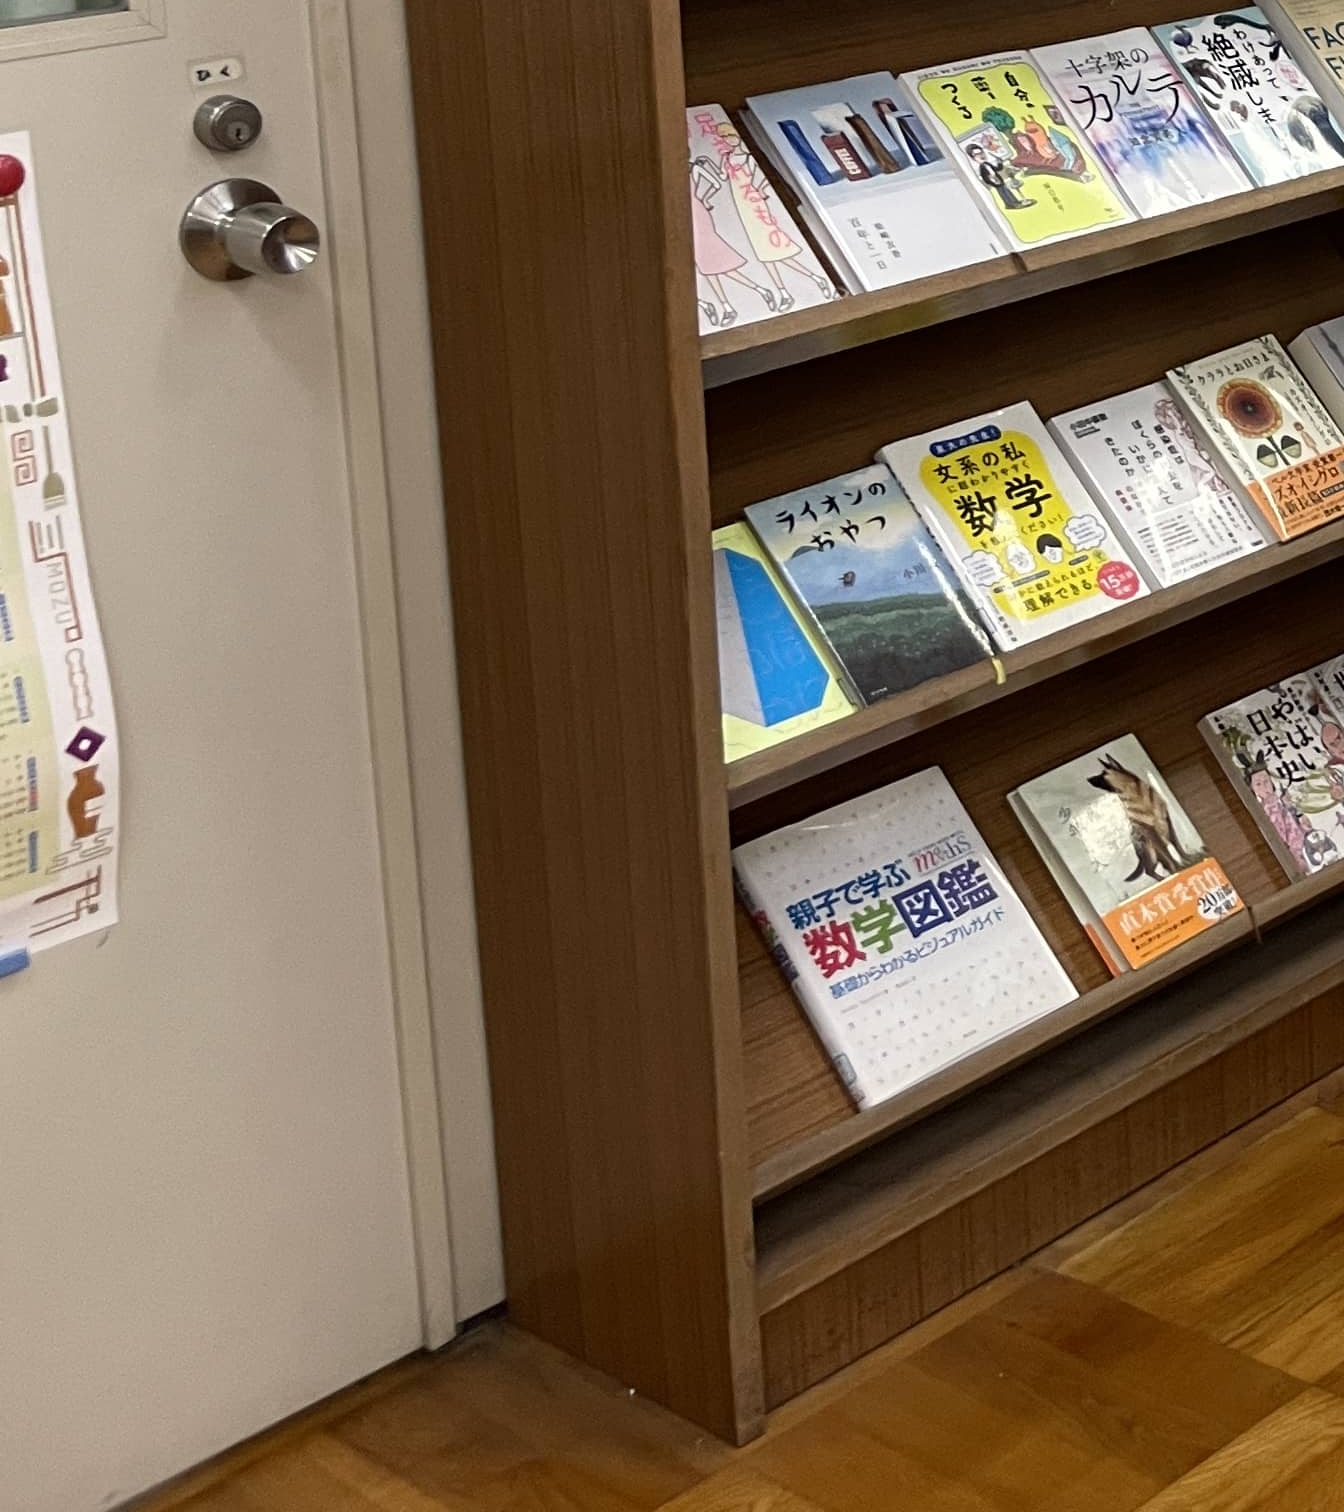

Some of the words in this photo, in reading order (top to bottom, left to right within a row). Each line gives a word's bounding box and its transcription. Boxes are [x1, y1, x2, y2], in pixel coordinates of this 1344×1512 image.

[1065, 47, 1150, 78] 十字架の
[1232, 28, 1281, 90] わけあって
[940, 83, 973, 120] つくる
[1070, 69, 1184, 130] カルテ
[933, 441, 1026, 484] 文系の私
[775, 482, 886, 534] ライオンの
[811, 514, 888, 553] おやつ
[953, 473, 1052, 538] 数学
[1247, 709, 1305, 786] 日本史
[1271, 697, 1322, 771] やばい
[785, 858, 912, 931] 親子で学ぶ
[802, 858, 1000, 979] 数学図鑑
[829, 906, 1005, 999] 基礎からわかるビジュアルガイド
